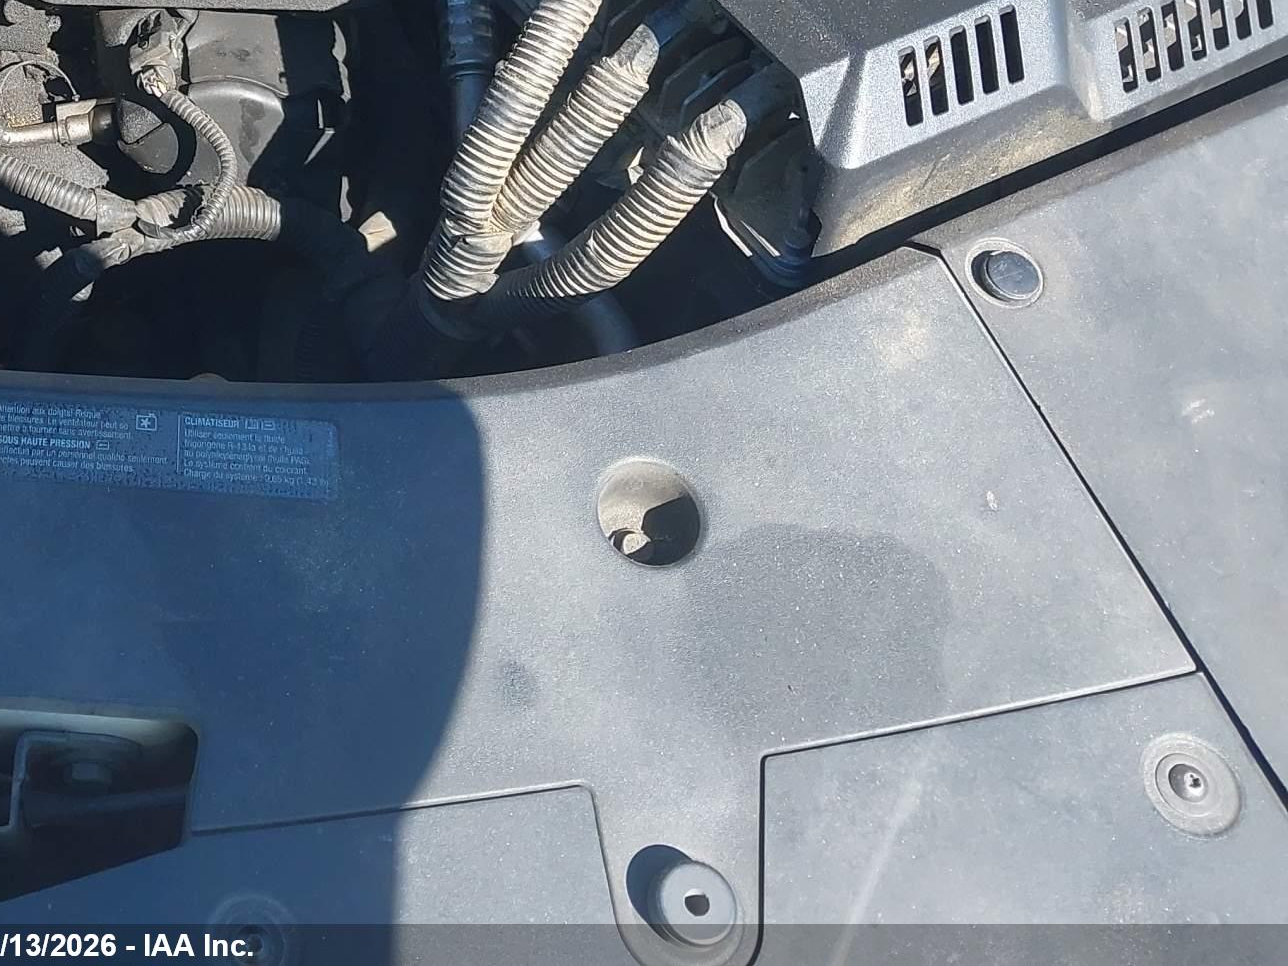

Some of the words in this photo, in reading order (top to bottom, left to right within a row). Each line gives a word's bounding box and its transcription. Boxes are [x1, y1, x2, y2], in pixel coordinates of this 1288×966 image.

[75, 409, 101, 420] Risque
[58, 417, 99, 428] ventilateur
[100, 420, 117, 431] peut
[184, 416, 238, 428] CLIMATISEUR
[20, 436, 48, 446] HAUTE
[49, 438, 90, 449] PRESSION
[57, 450, 96, 463] personnel
[20, 457, 50, 469] peuvent
[52, 459, 79, 468] causer
[183, 459, 194, 467] Le
[195, 459, 228, 471] système
[229, 462, 261, 471] contient
[183, 468, 211, 480] Charge
